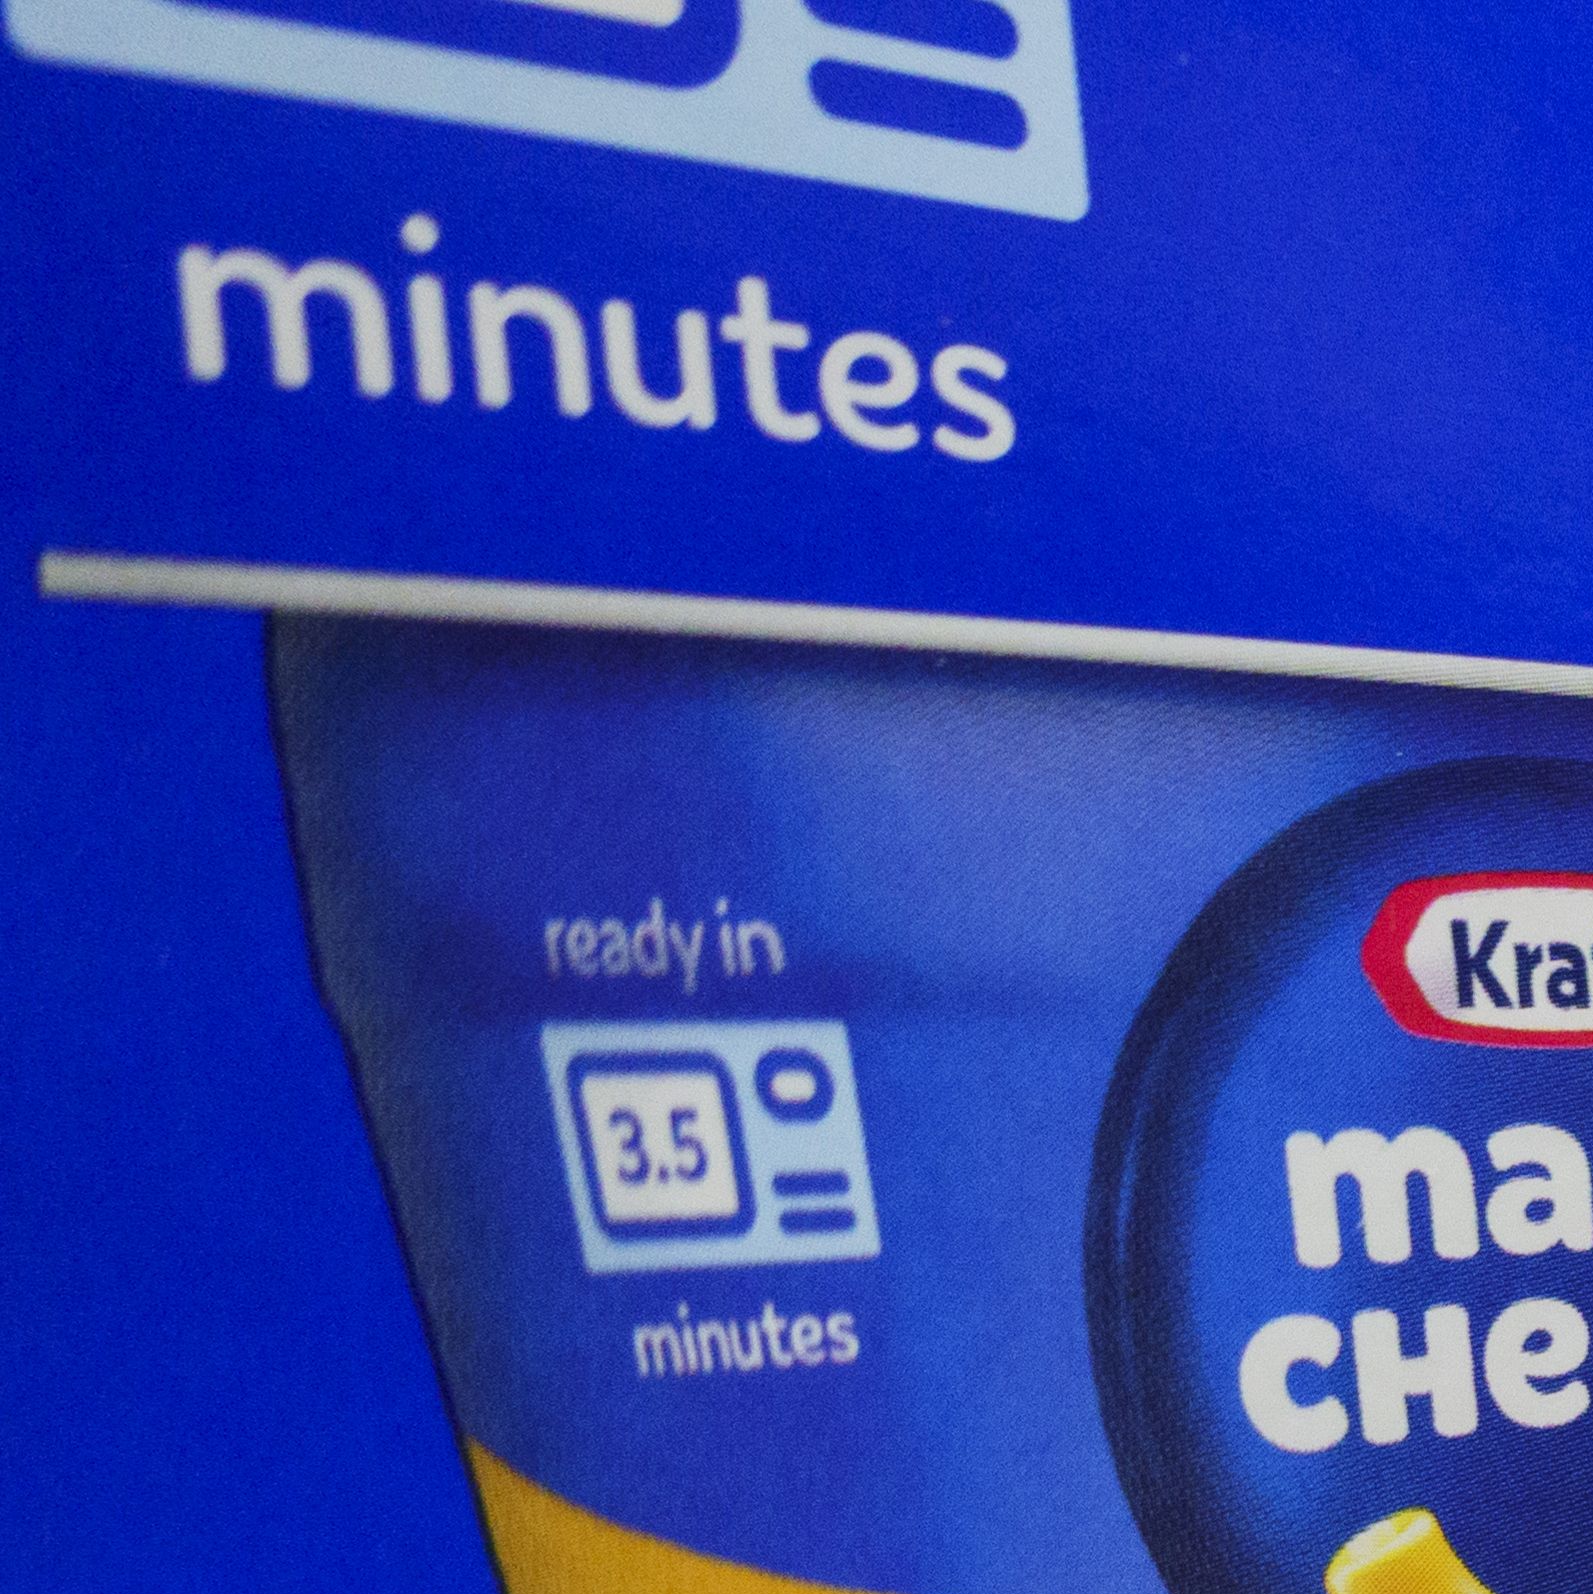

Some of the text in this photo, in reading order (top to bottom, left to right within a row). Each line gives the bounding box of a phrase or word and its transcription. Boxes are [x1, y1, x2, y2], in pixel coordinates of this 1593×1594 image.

[177, 213, 1017, 462] minutes
[545, 897, 785, 995] ready in
[608, 1107, 708, 1187] 3.5
[634, 1302, 860, 1380] minutes
